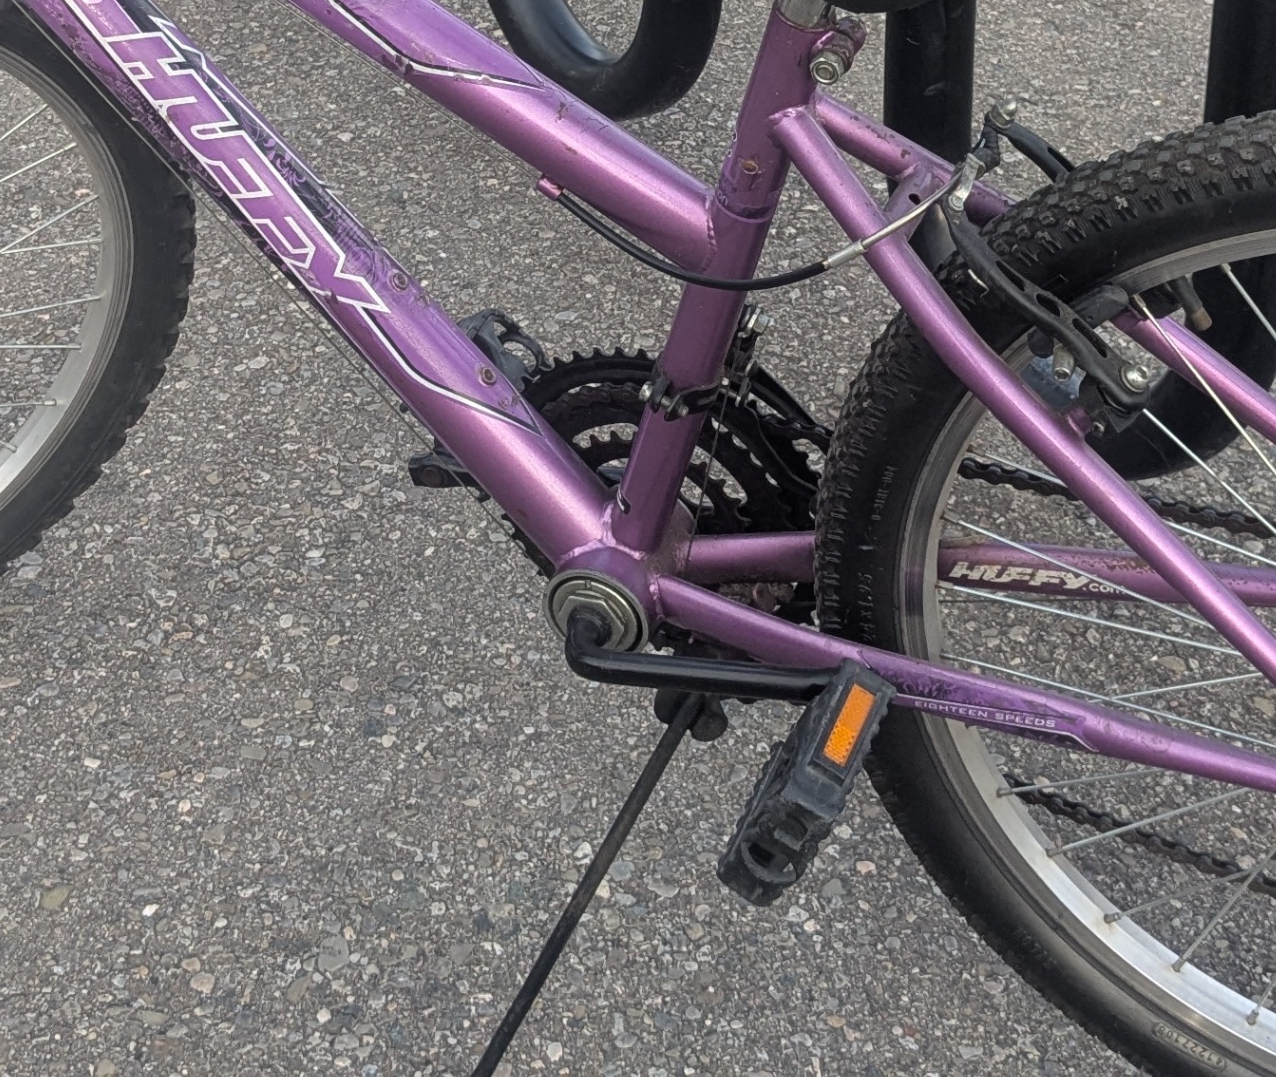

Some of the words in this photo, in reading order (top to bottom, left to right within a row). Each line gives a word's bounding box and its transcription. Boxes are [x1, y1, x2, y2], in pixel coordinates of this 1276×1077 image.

[101, 29, 392, 314] HUFFY
[914, 700, 988, 718] EIGHTEEN
[994, 711, 1056, 728] SPEEDS
